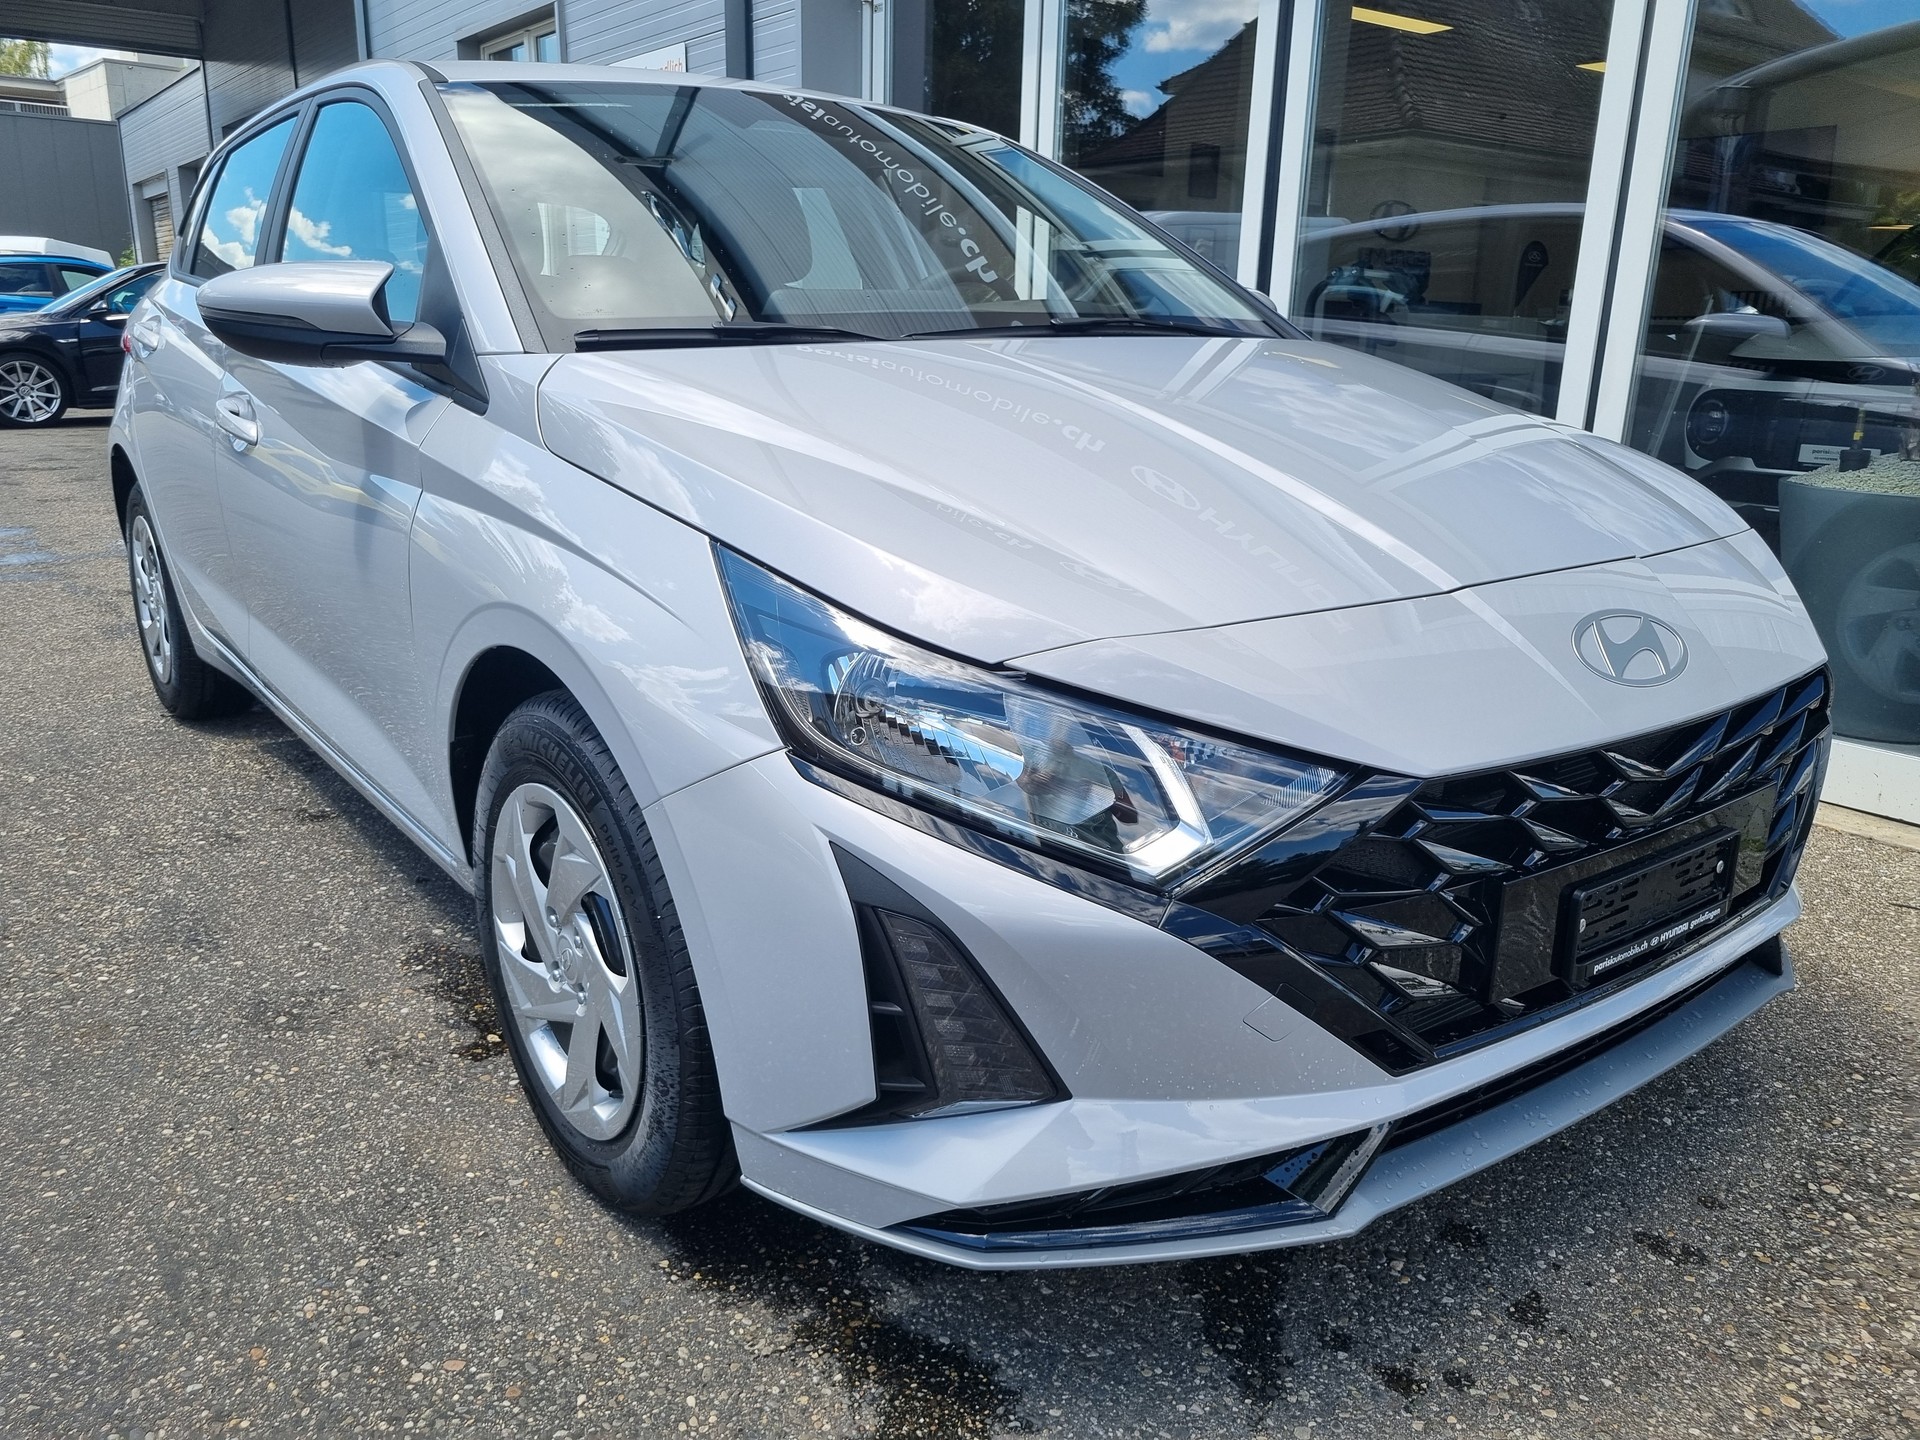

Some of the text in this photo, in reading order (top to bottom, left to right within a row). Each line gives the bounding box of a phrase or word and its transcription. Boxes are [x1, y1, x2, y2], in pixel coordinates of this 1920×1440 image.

[660, 57, 683, 73] dlich
[520, 728, 596, 805] MICHELIN
[599, 823, 640, 912] PRIMACY
[1593, 940, 1649, 975] parisiautomobile.ch
[1660, 921, 1689, 942] HYUNDAI
